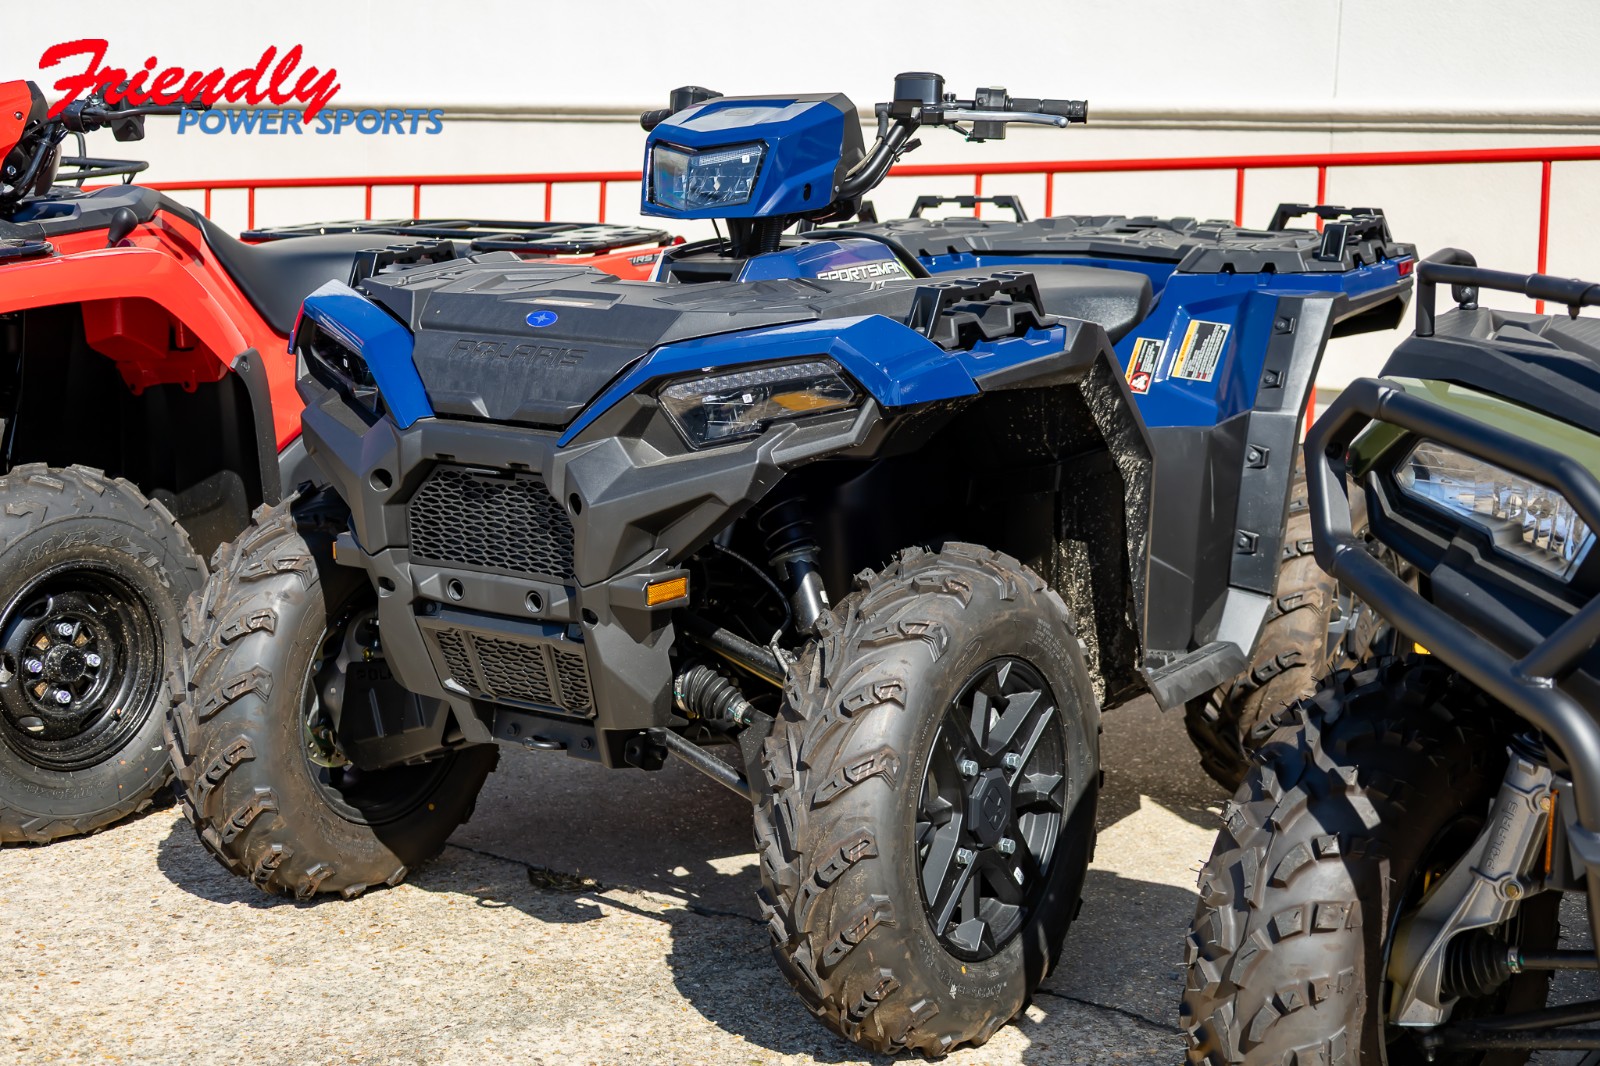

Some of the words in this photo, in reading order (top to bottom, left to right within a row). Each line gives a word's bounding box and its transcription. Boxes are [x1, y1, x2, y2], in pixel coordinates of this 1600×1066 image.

[817, 261, 906, 281] SPORTSMAN
[449, 338, 589, 367] POLARIS
[1485, 799, 1519, 870] POLARIS
